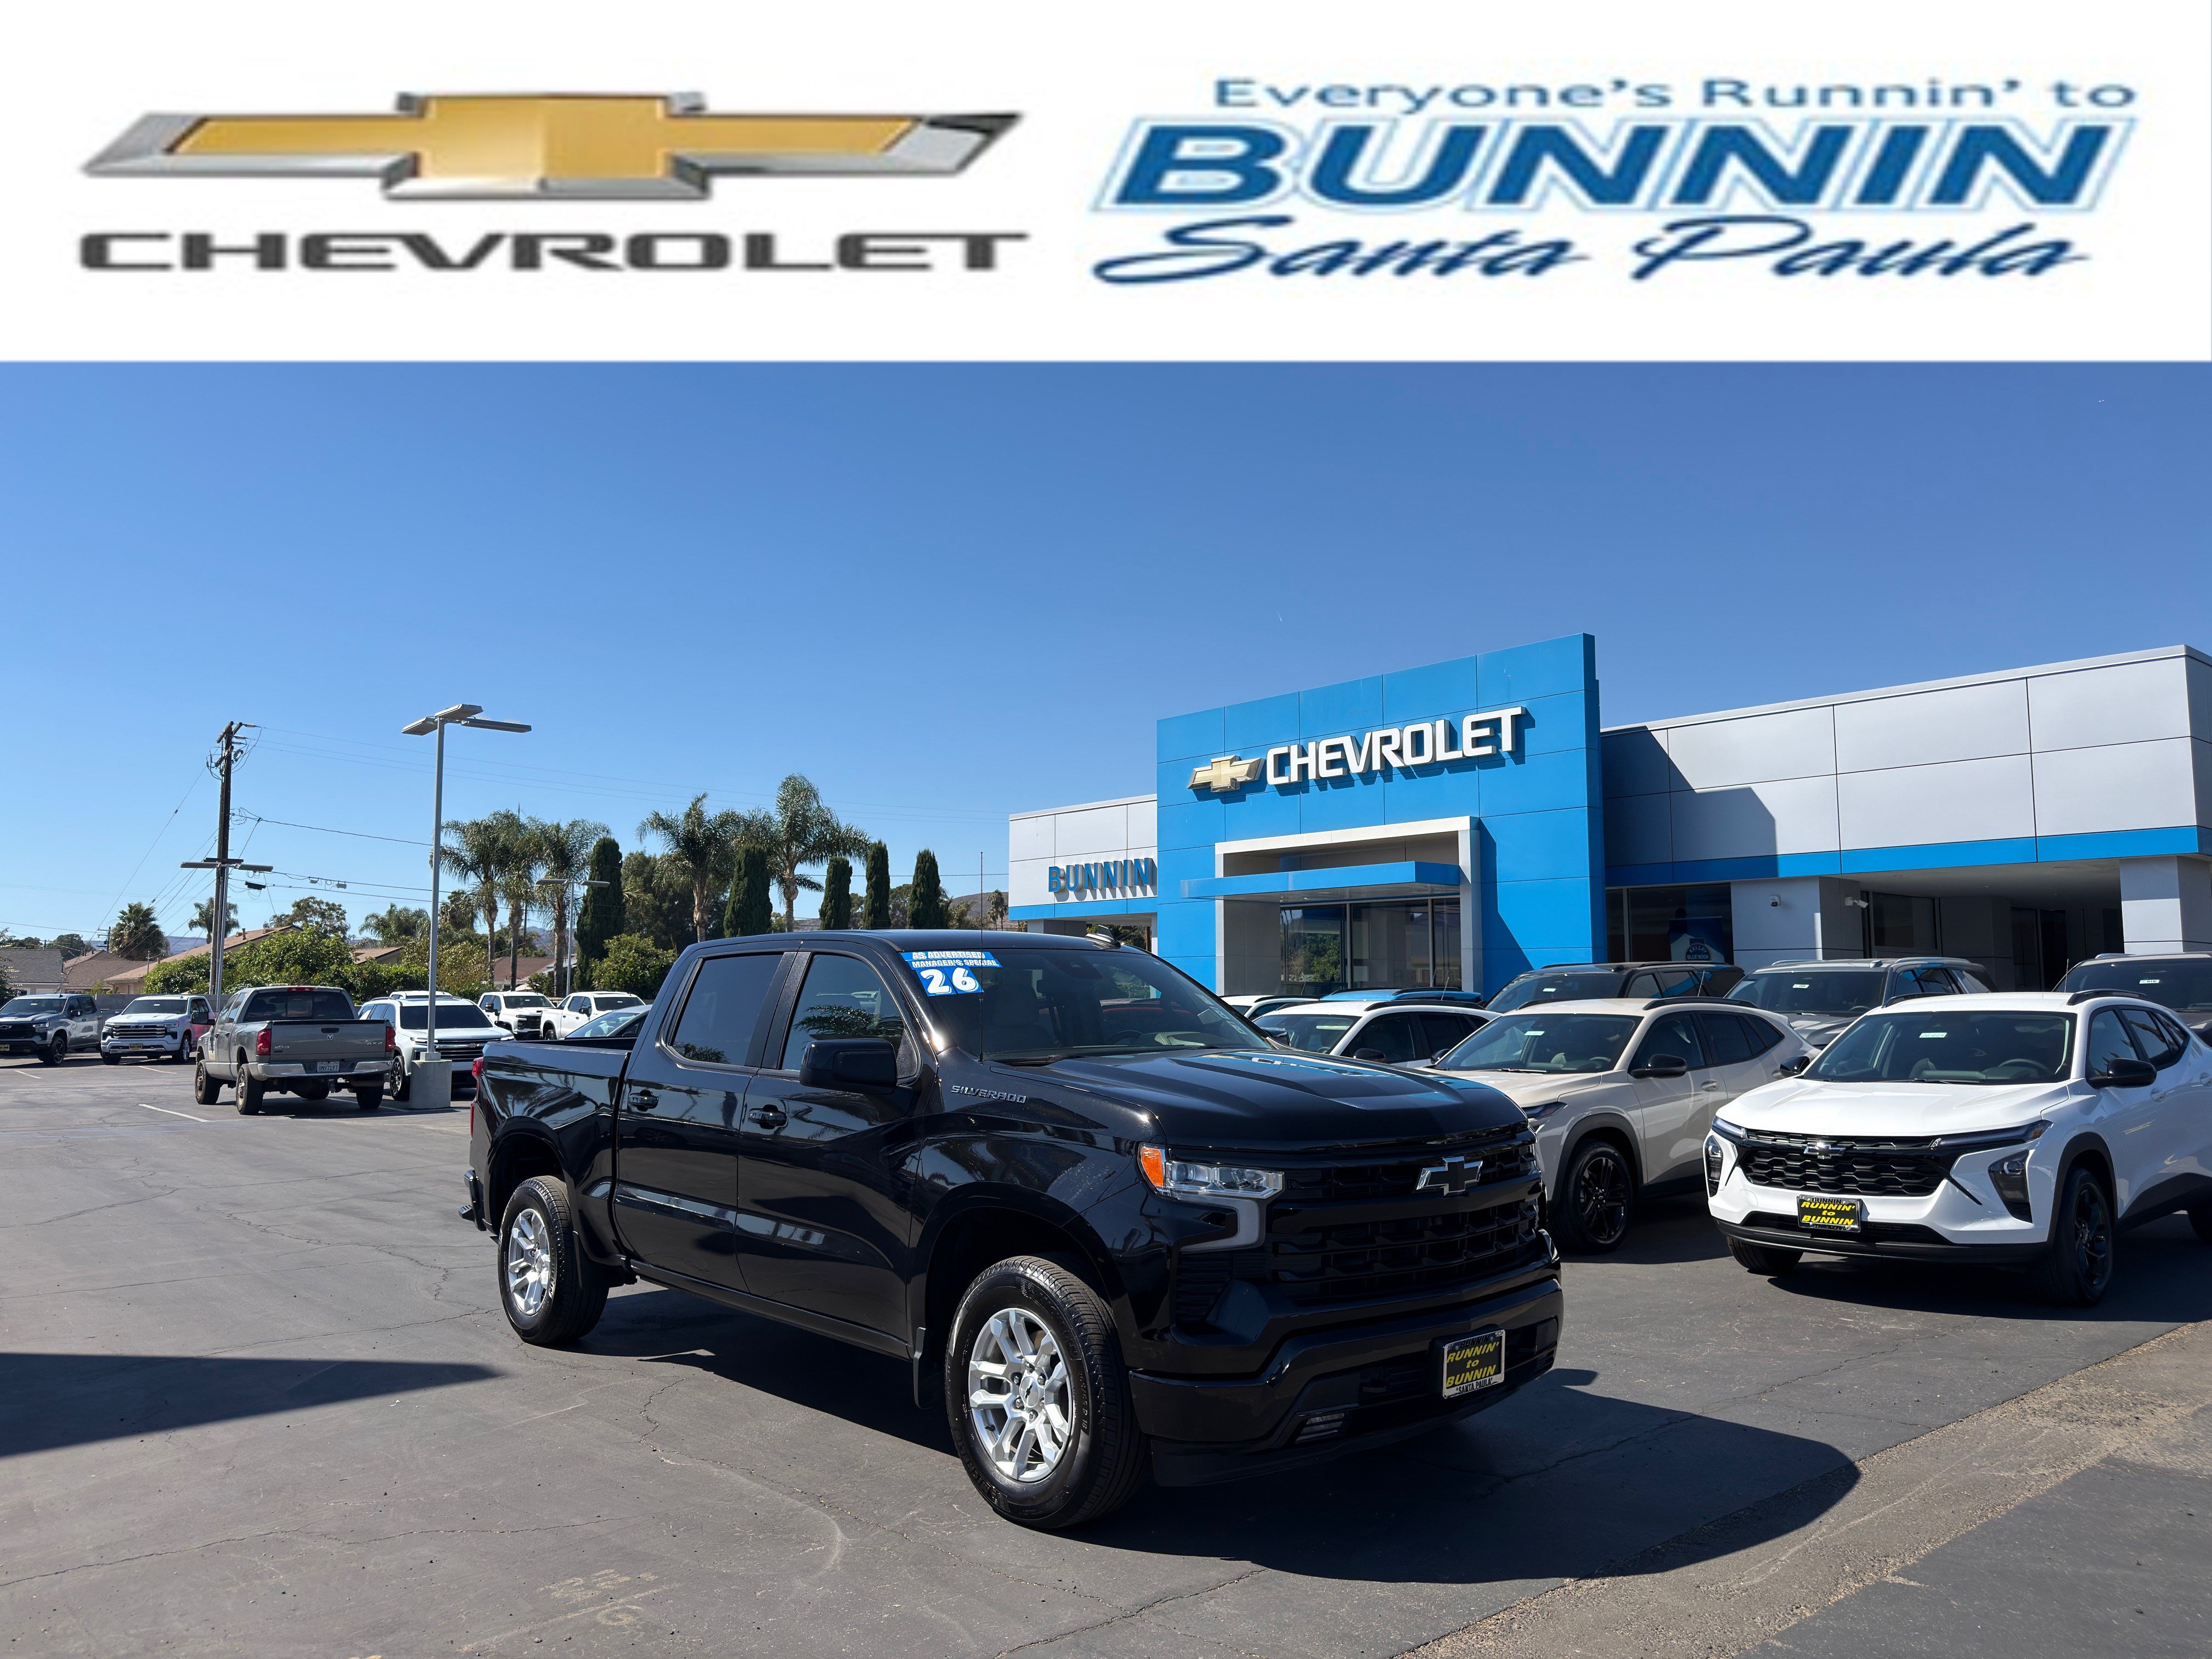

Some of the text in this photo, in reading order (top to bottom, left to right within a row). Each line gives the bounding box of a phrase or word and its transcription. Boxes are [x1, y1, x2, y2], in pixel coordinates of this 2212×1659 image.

[1266, 706, 1526, 785] CHEVROLET
[1048, 857, 1153, 893] BUNNIN
[928, 951, 986, 959] ADVERTISED
[1689, 945, 1708, 953] KELLEY
[912, 960, 964, 968] MANAGER'S
[920, 967, 979, 994] 26
[951, 1085, 1028, 1104] SILVERADO
[1801, 1201, 1855, 1211] RUNNIN'
[1802, 1215, 1854, 1226] BUNNIN
[1447, 1341, 1500, 1363] RUNNIN'
[1466, 1359, 1480, 1368] to
[1446, 1364, 1497, 1387] BUNNIN
